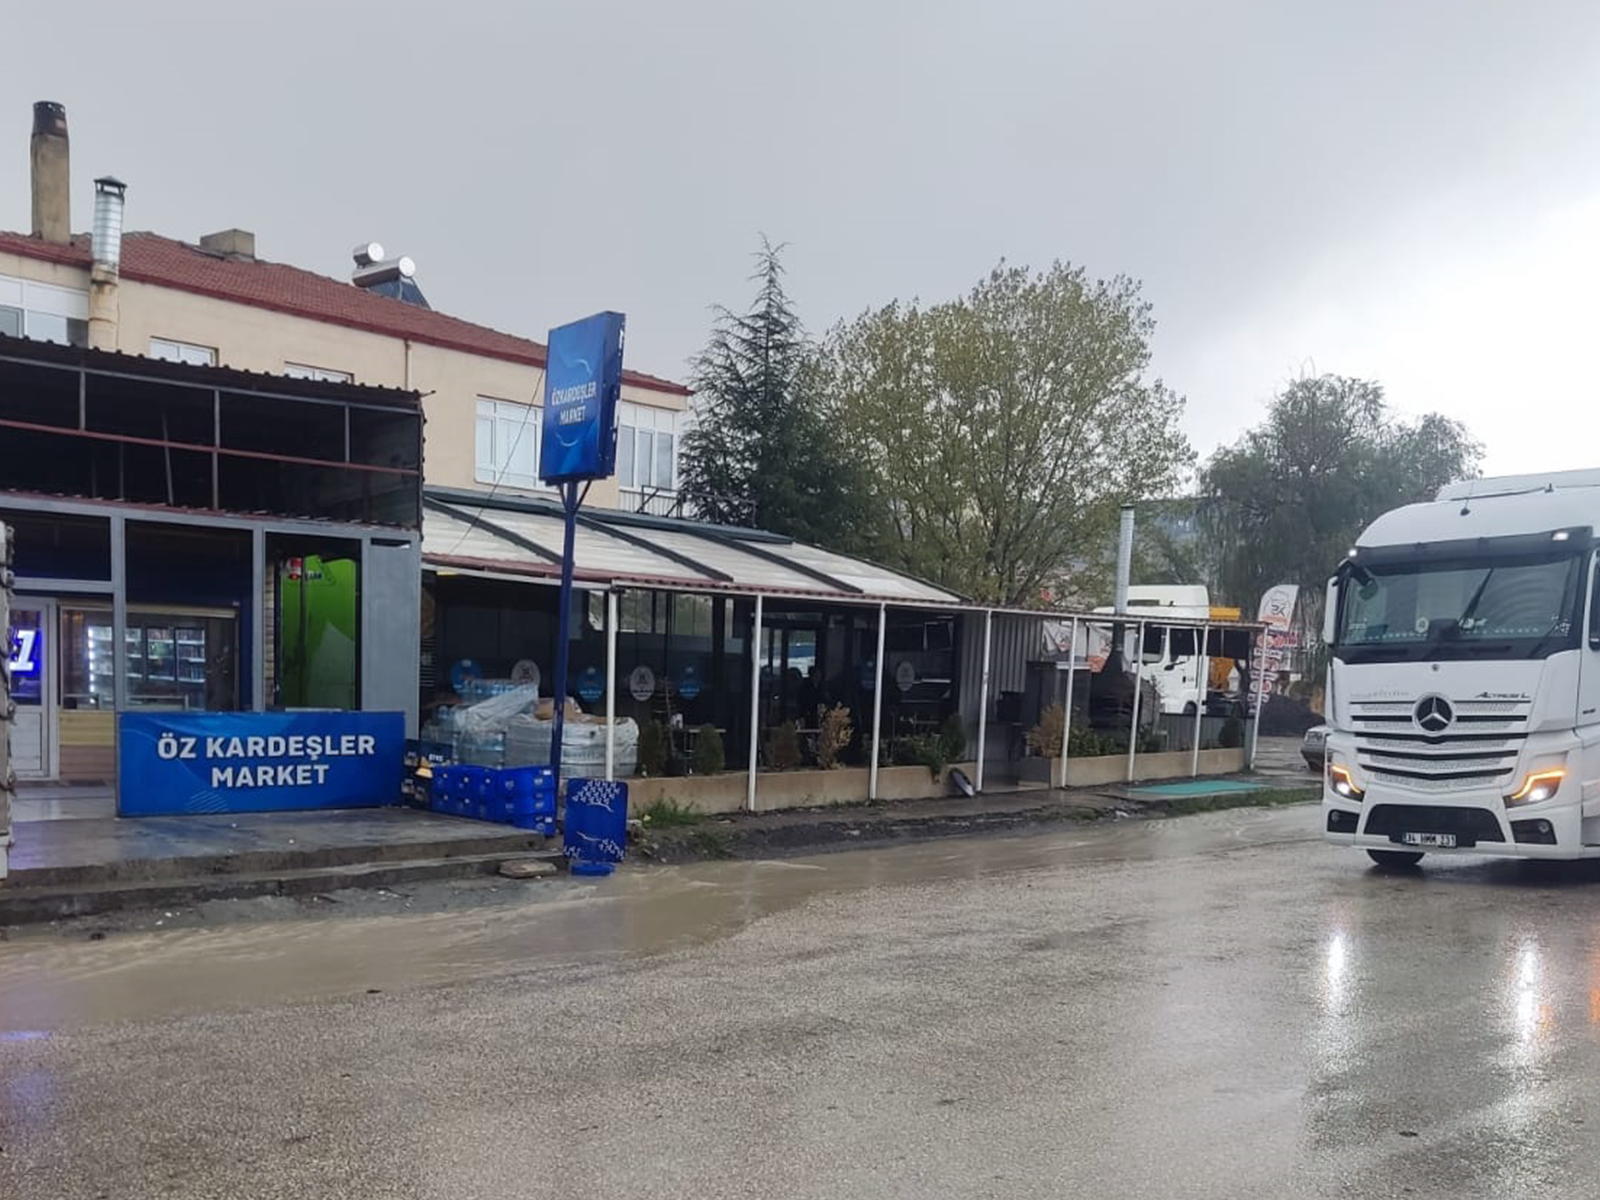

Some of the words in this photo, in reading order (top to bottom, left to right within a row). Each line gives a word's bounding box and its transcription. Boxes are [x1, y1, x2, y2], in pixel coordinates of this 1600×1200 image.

[559, 405, 586, 426] MARKET
[157, 732, 197, 759] ÖZ
[206, 735, 376, 761] KARDEŞLER
[211, 764, 330, 788] MARKET
